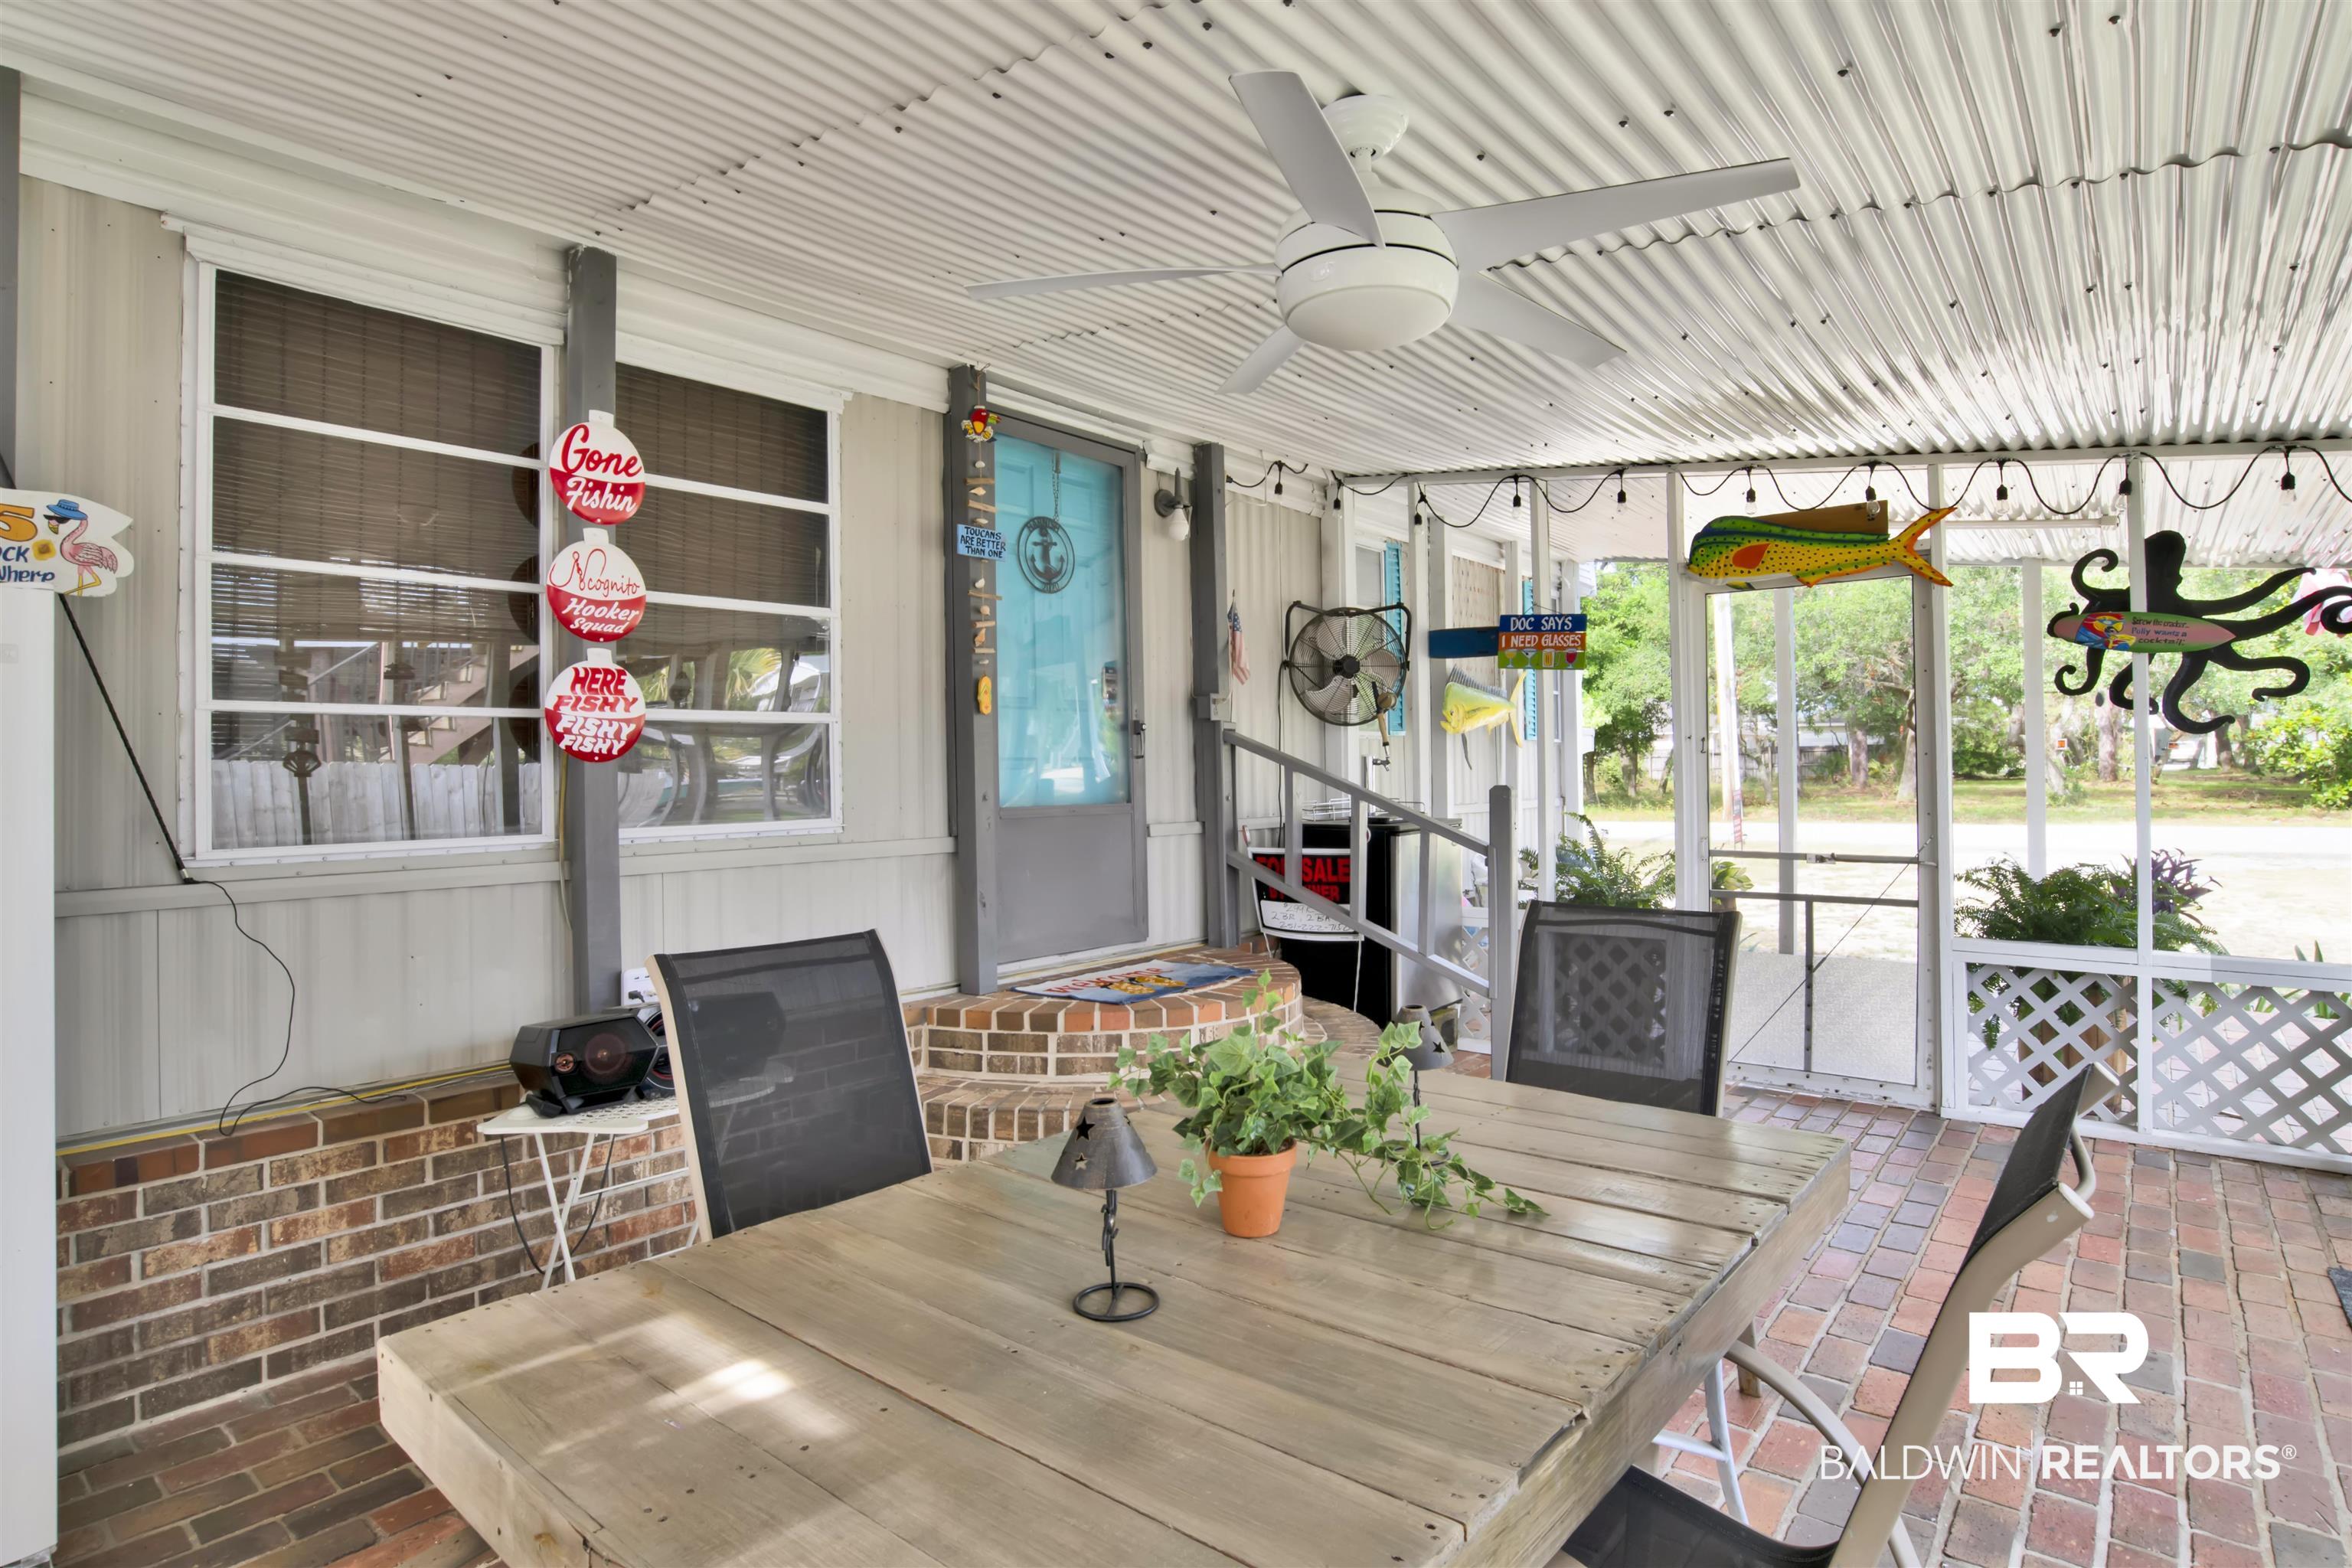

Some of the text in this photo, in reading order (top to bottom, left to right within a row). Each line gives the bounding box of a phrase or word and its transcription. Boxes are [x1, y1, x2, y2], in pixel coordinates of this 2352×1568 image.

[561, 424, 642, 477] Gone
[567, 477, 636, 512] Fishin
[961, 534, 1006, 551] ARE BETTER
[965, 527, 1001, 540] TOUCANS
[965, 546, 1003, 558] THAN ONE
[561, 598, 639, 620] Hooker
[570, 618, 629, 634] Squad
[1511, 616, 1572, 631] DOC SAYS
[2132, 627, 2151, 636] Polly
[1502, 634, 1581, 648] I NEED GLASSES
[570, 667, 627, 696] HERE
[553, 695, 638, 713] FISHY
[556, 714, 636, 740] FISHY
[559, 734, 626, 755] FISHY
[1302, 858, 1351, 883] SALE
